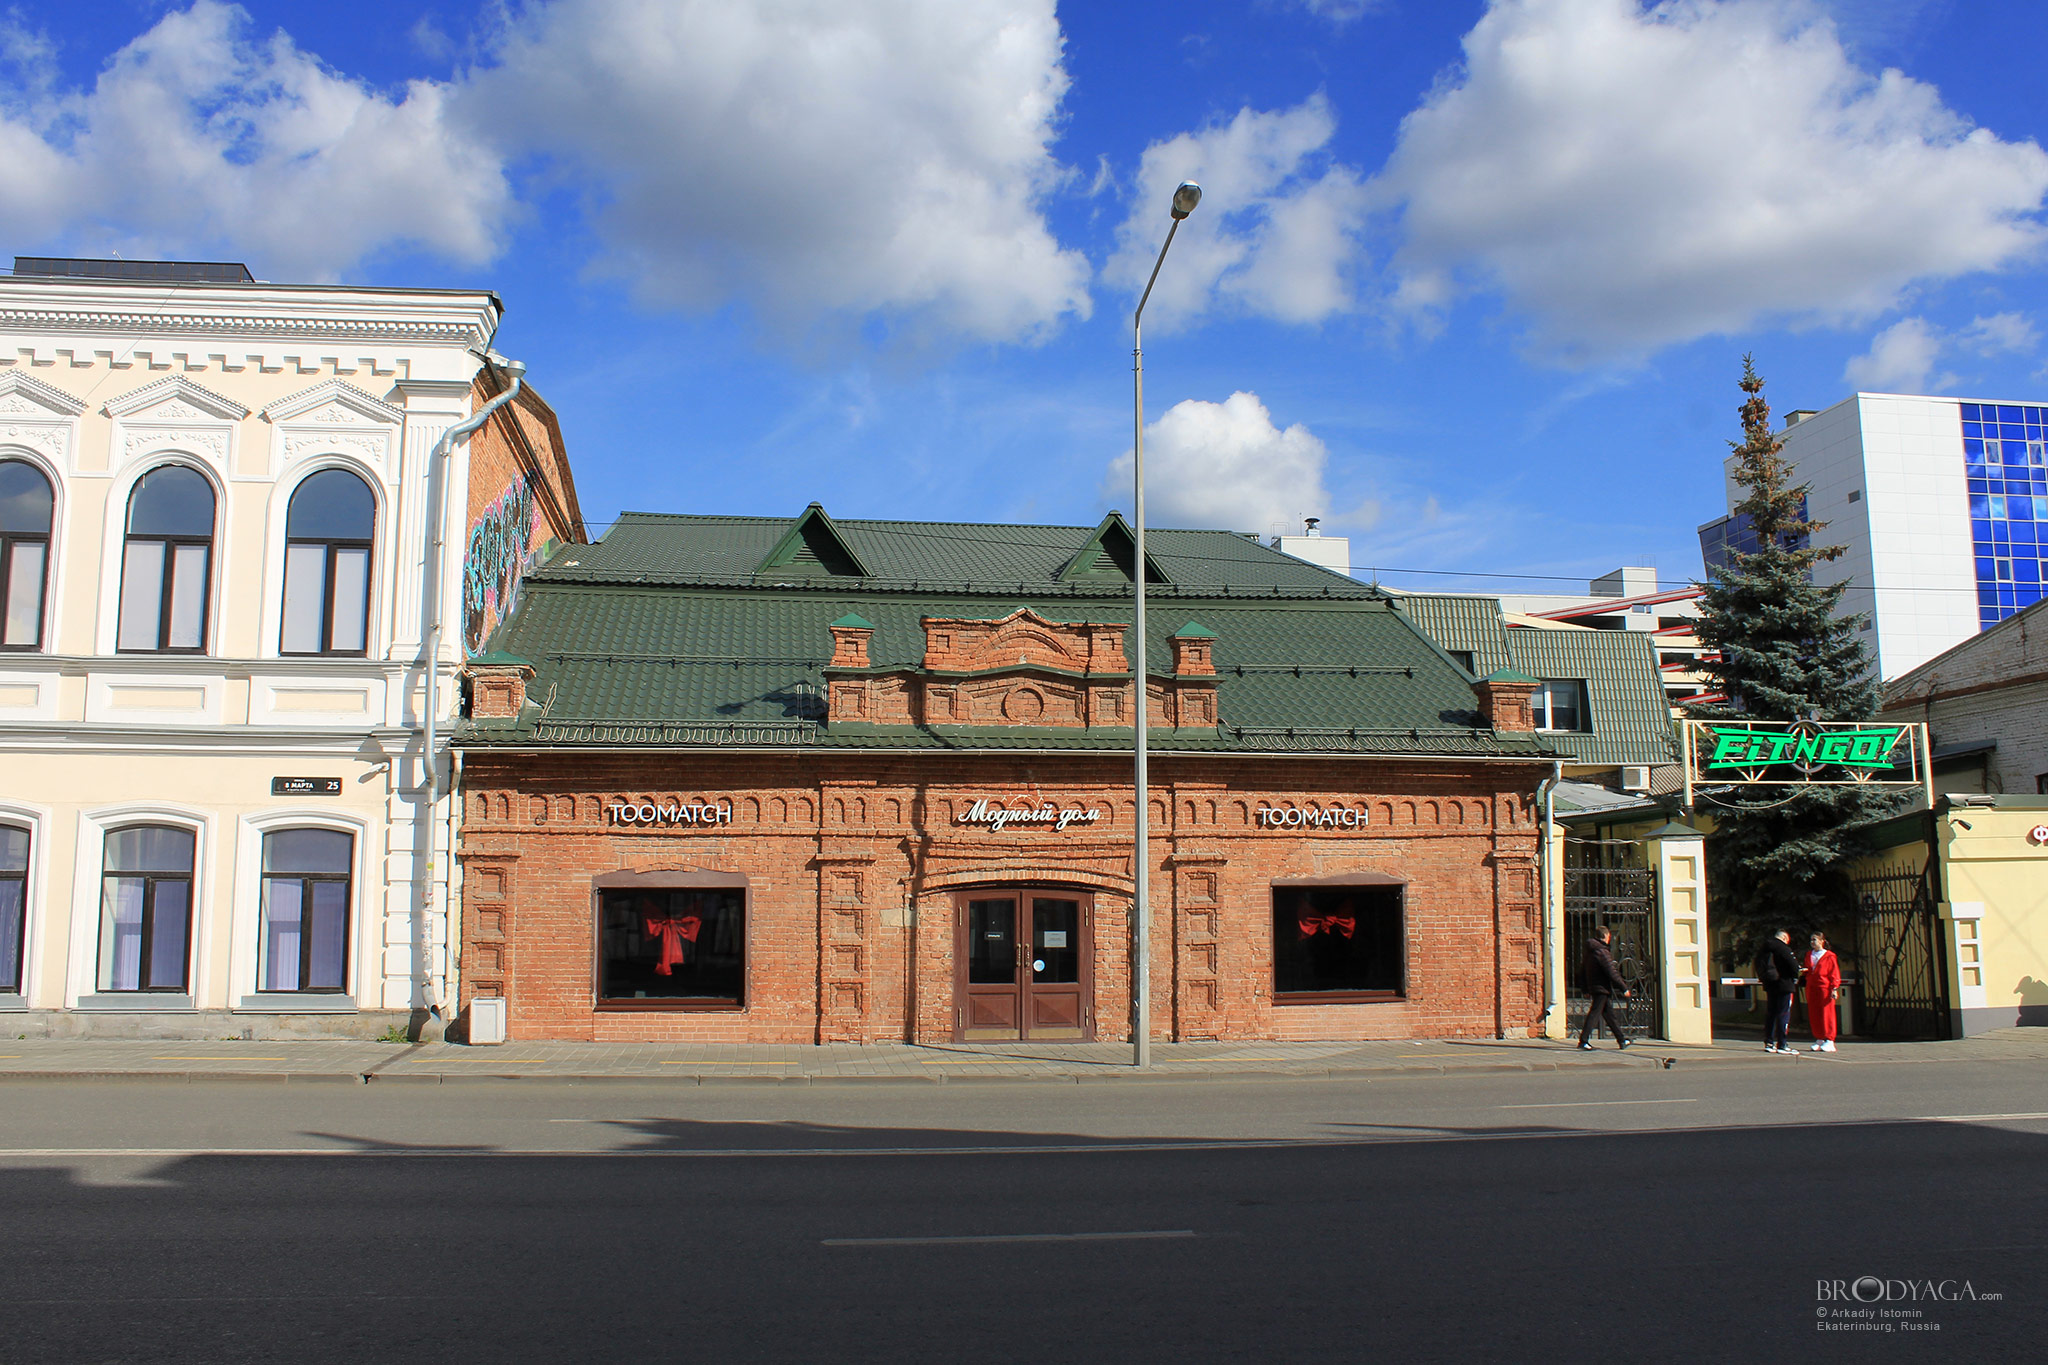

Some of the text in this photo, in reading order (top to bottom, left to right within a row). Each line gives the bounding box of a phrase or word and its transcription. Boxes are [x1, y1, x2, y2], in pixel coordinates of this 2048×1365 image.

[327, 781, 339, 790] 25
[608, 804, 732, 823] TOOMATCH
[958, 799, 1101, 831] Модный дом
[1257, 807, 1369, 826] TOOMATCH
